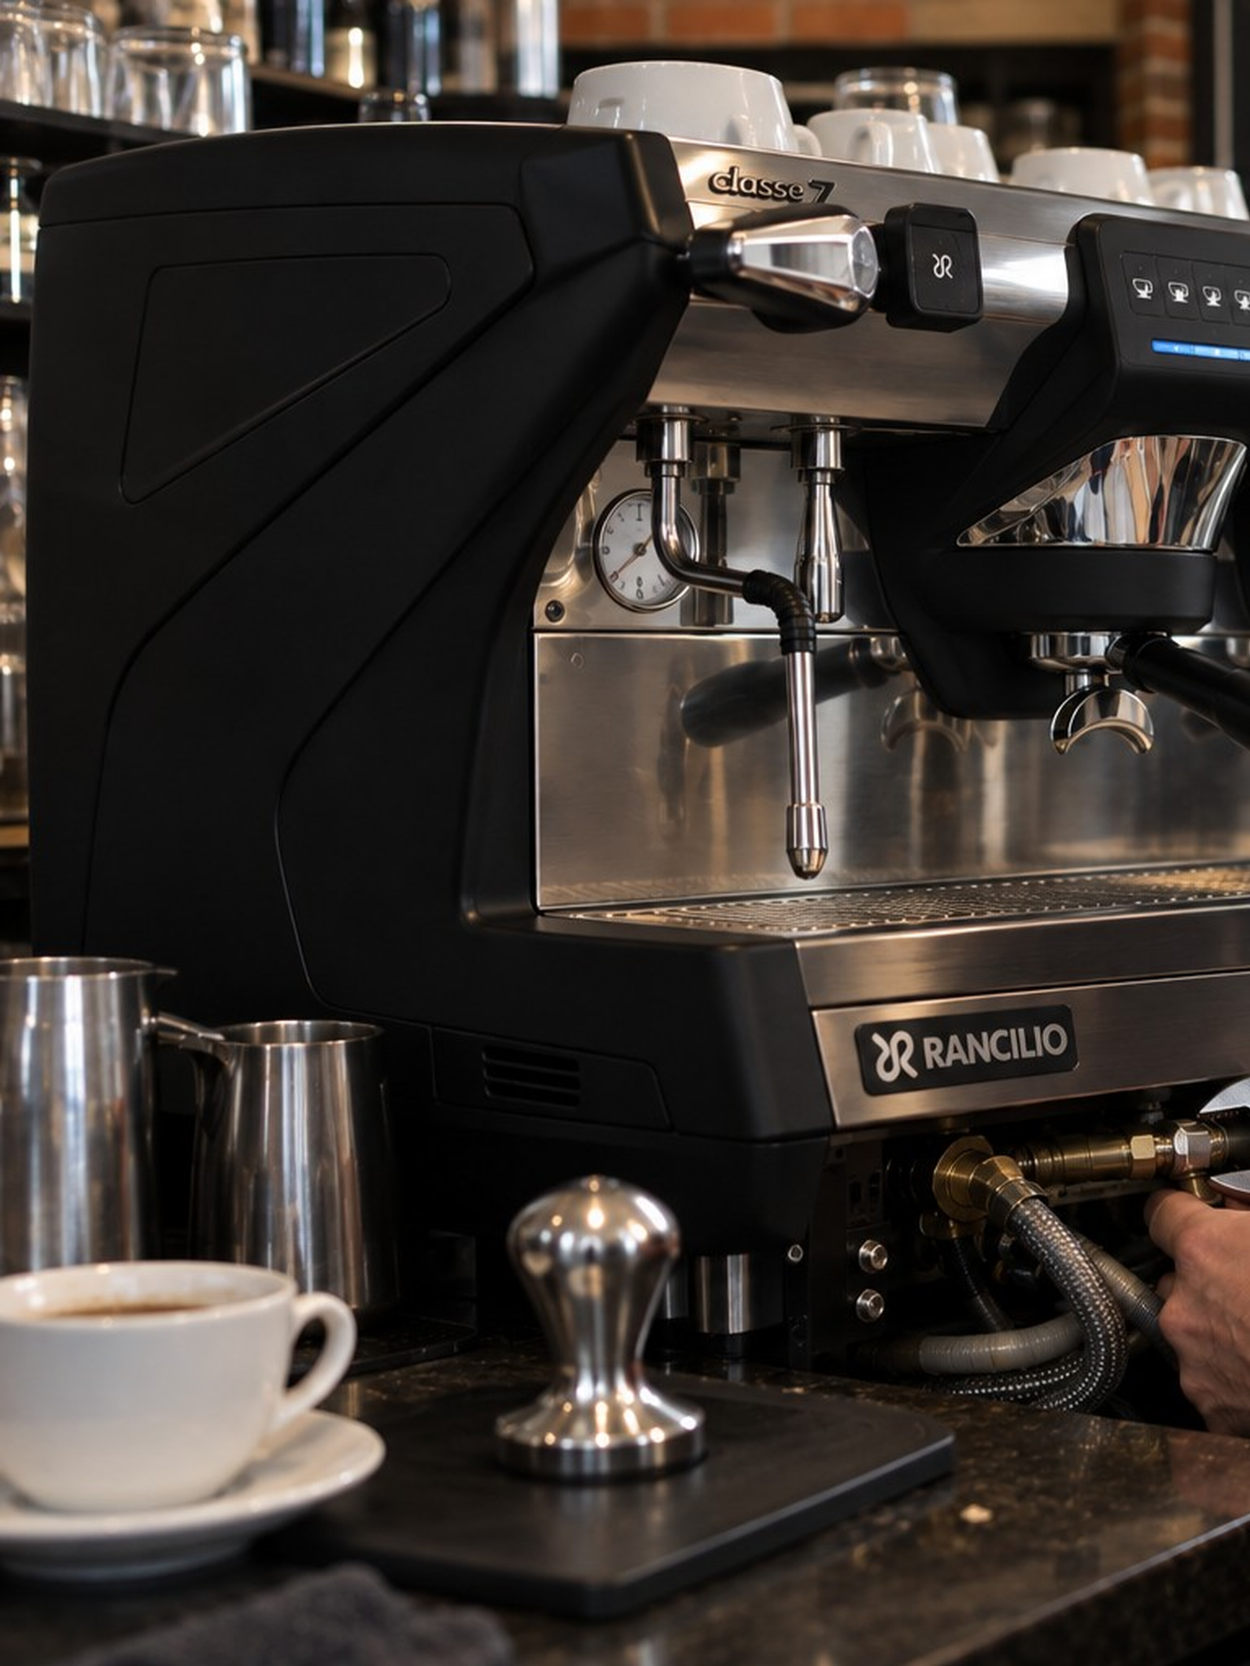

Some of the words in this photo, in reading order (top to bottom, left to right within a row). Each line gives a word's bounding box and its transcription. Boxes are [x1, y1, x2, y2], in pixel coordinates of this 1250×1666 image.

[708, 166, 805, 203] classe
[808, 180, 836, 204] 7
[923, 1023, 1068, 1070] RANCILIO
